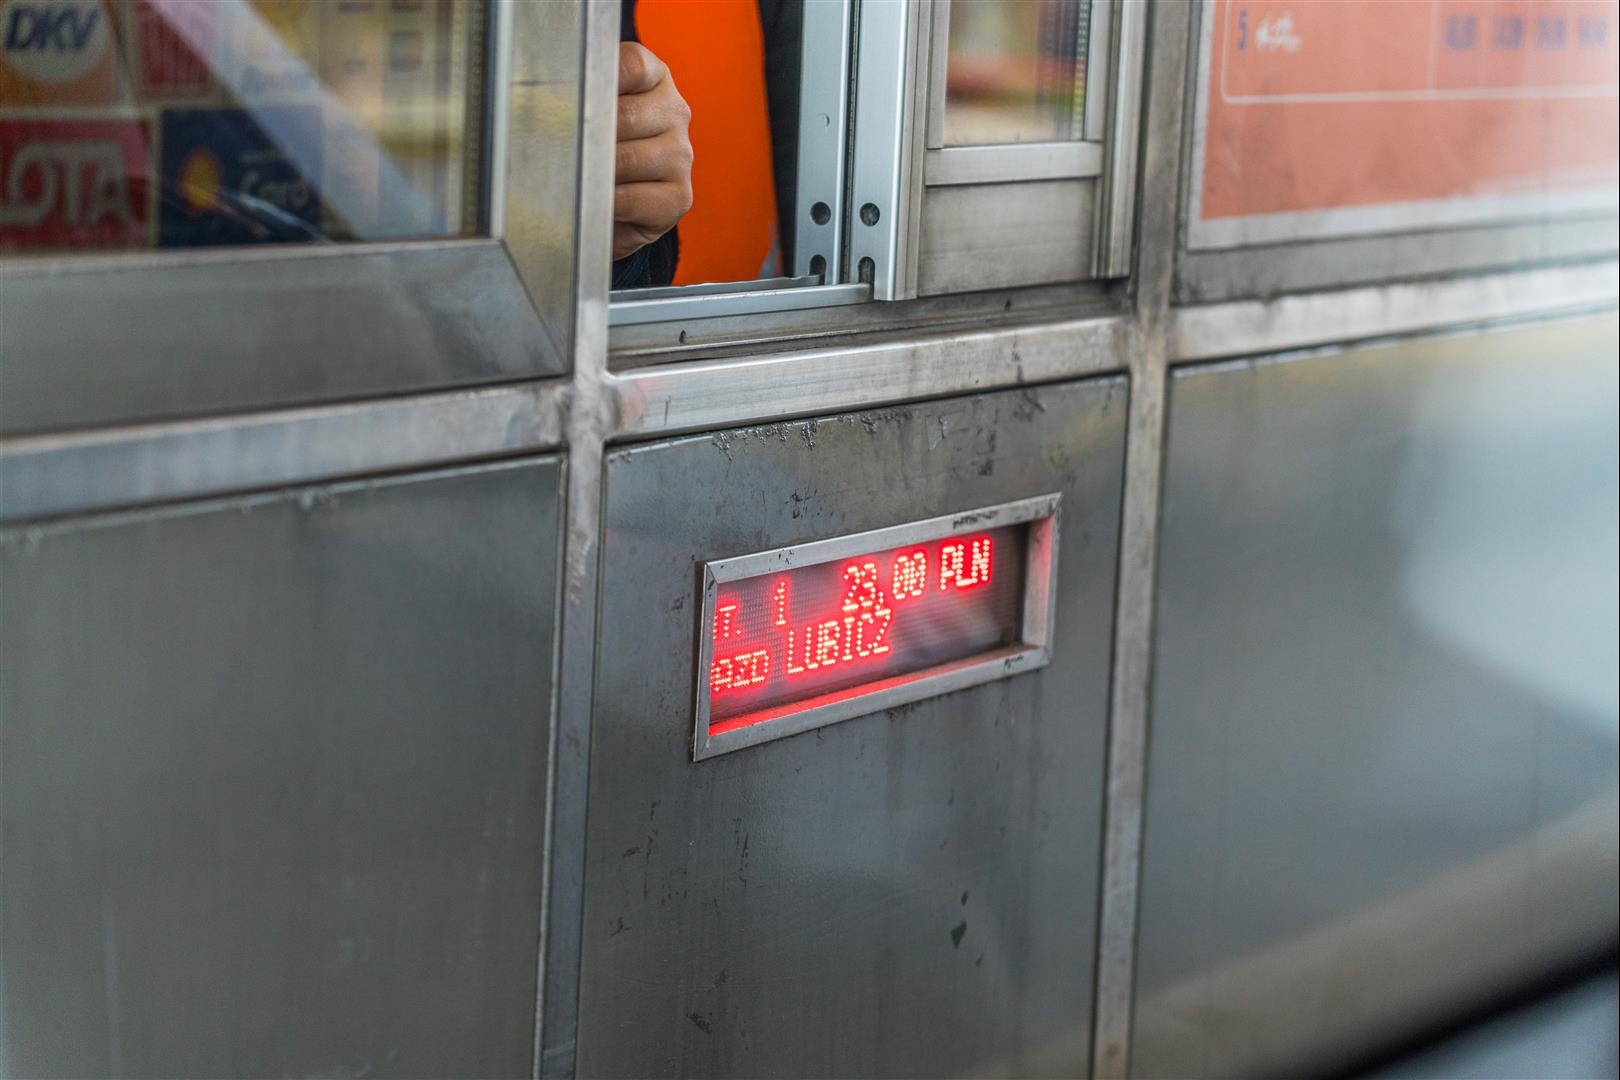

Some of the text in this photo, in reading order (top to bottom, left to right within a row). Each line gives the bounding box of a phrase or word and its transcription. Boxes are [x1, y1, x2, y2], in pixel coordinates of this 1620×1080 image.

[7, 8, 99, 50] DKV
[773, 581, 787, 626] 1
[841, 552, 927, 613] 23,00
[939, 538, 990, 590] PLN
[787, 607, 892, 674] LUBICZ
